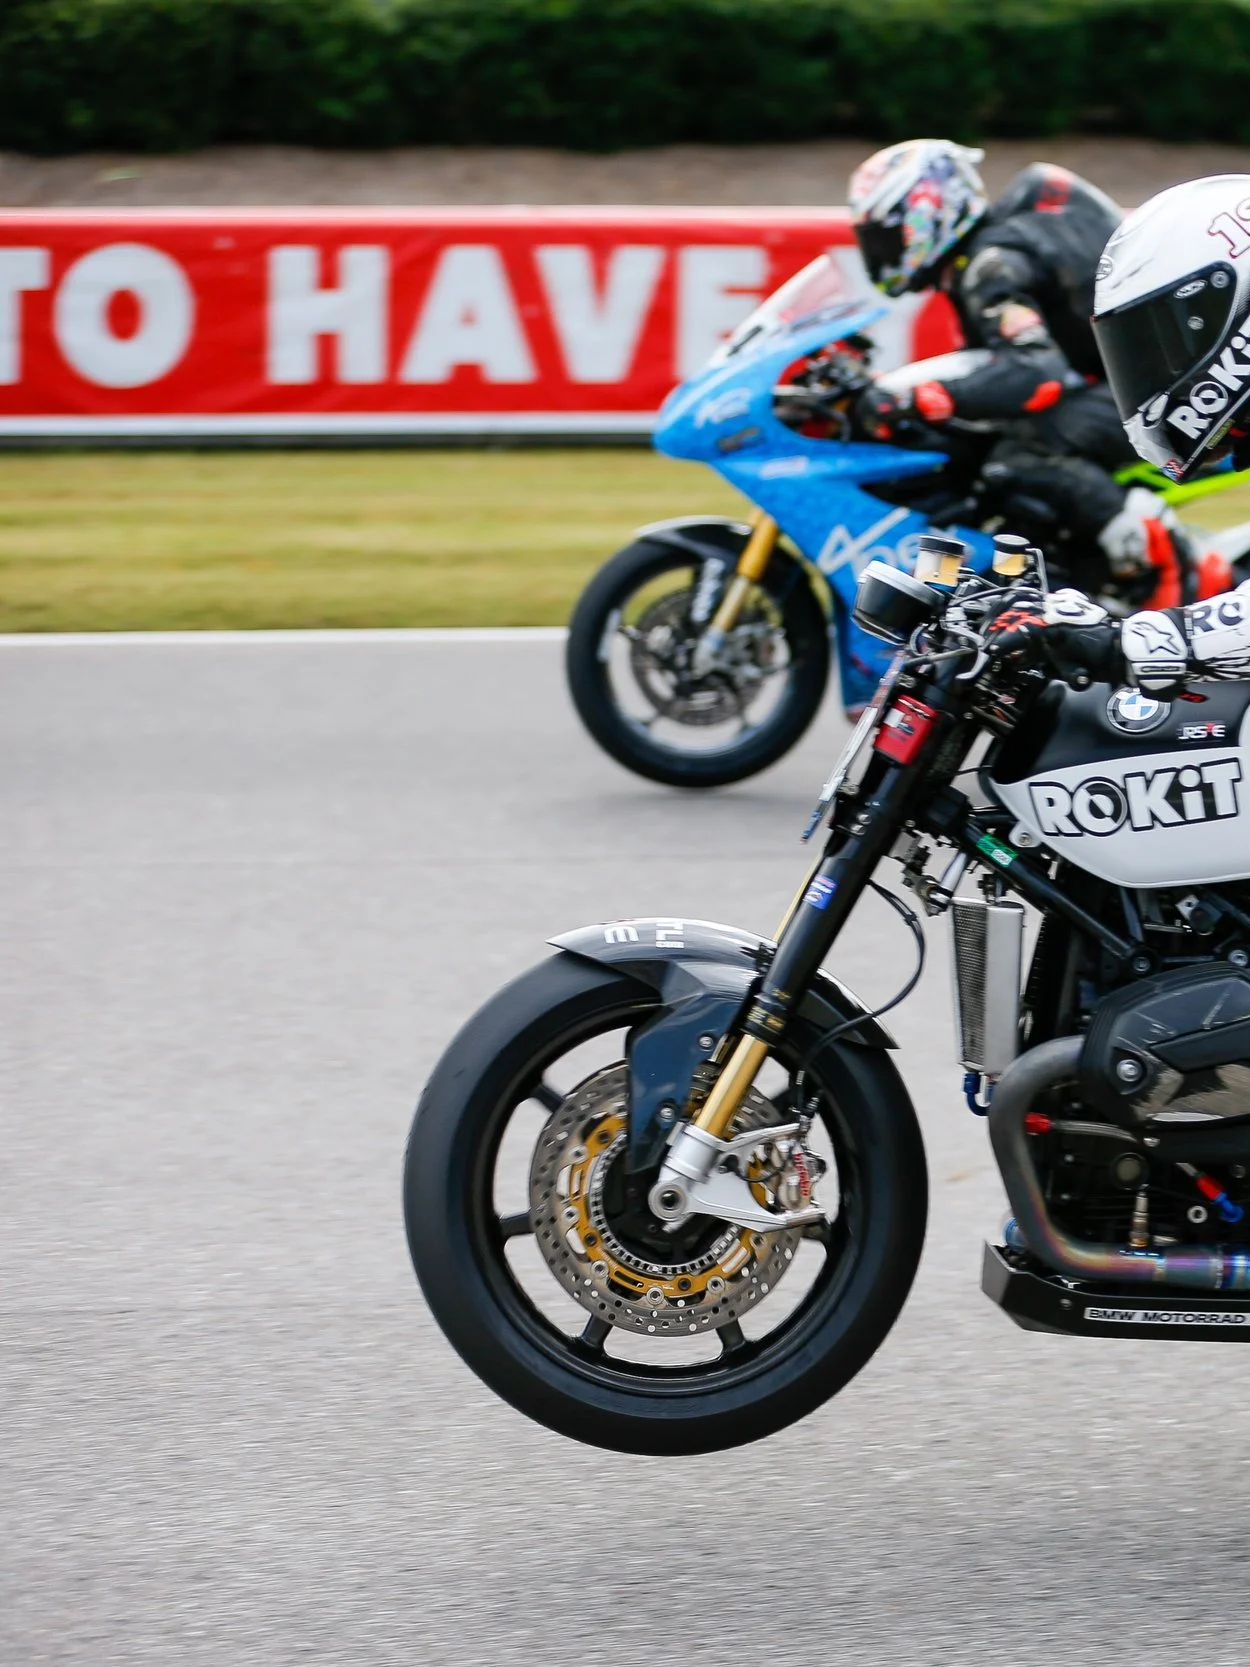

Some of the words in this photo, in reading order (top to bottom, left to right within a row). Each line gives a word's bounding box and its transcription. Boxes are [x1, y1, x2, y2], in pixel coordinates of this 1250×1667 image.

[266, 244, 770, 385] HAVE
[1089, 1308, 1135, 1322] BMW
[1141, 1311, 1246, 1325] MOTORRAD
